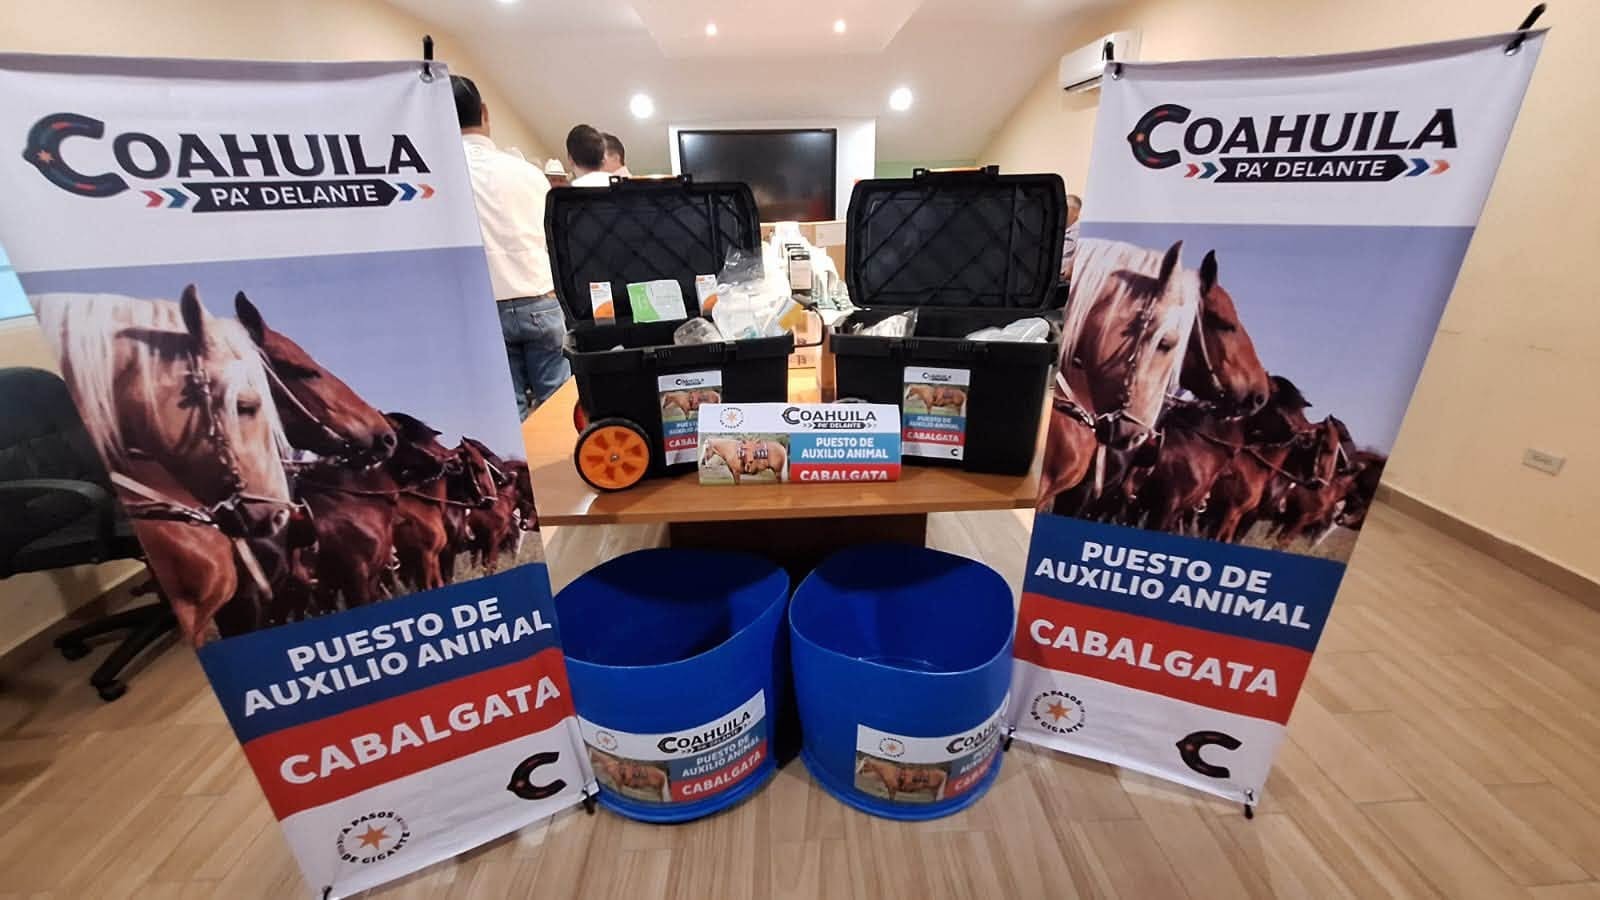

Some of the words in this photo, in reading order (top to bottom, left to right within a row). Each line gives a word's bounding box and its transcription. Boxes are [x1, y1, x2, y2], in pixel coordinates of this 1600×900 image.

[22, 112, 431, 198] COAHUILA
[1127, 103, 1457, 169] COAHUILA
[1234, 162, 1268, 179] PA'
[1275, 160, 1386, 178] DELANTE
[210, 187, 249, 206] PA'
[261, 183, 379, 204] DELANTE
[781, 406, 877, 425] COAHUILA
[668, 437, 696, 448] CABAL
[801, 448, 845, 459] AUXILIO
[846, 448, 888, 459] ANIMAL
[815, 437, 858, 447] PUESTO
[859, 437, 874, 447] DE
[800, 470, 888, 480] CABALGATA
[1081, 541, 1212, 583] PUESTO
[1219, 565, 1272, 595] DE
[1034, 558, 1164, 599] AUXILIO
[1168, 584, 1311, 629] ANIMAL
[287, 612, 444, 673] PUESTO
[452, 597, 502, 629] DE
[244, 651, 409, 717] AUXILIO
[418, 610, 552, 668] ANIMAL
[1029, 618, 1278, 697] CABALGATA
[279, 675, 561, 785] CABALGATA
[656, 711, 751, 753] COAHUILA
[681, 759, 726, 777] AUXILIO
[681, 750, 761, 796] CABALGATA
